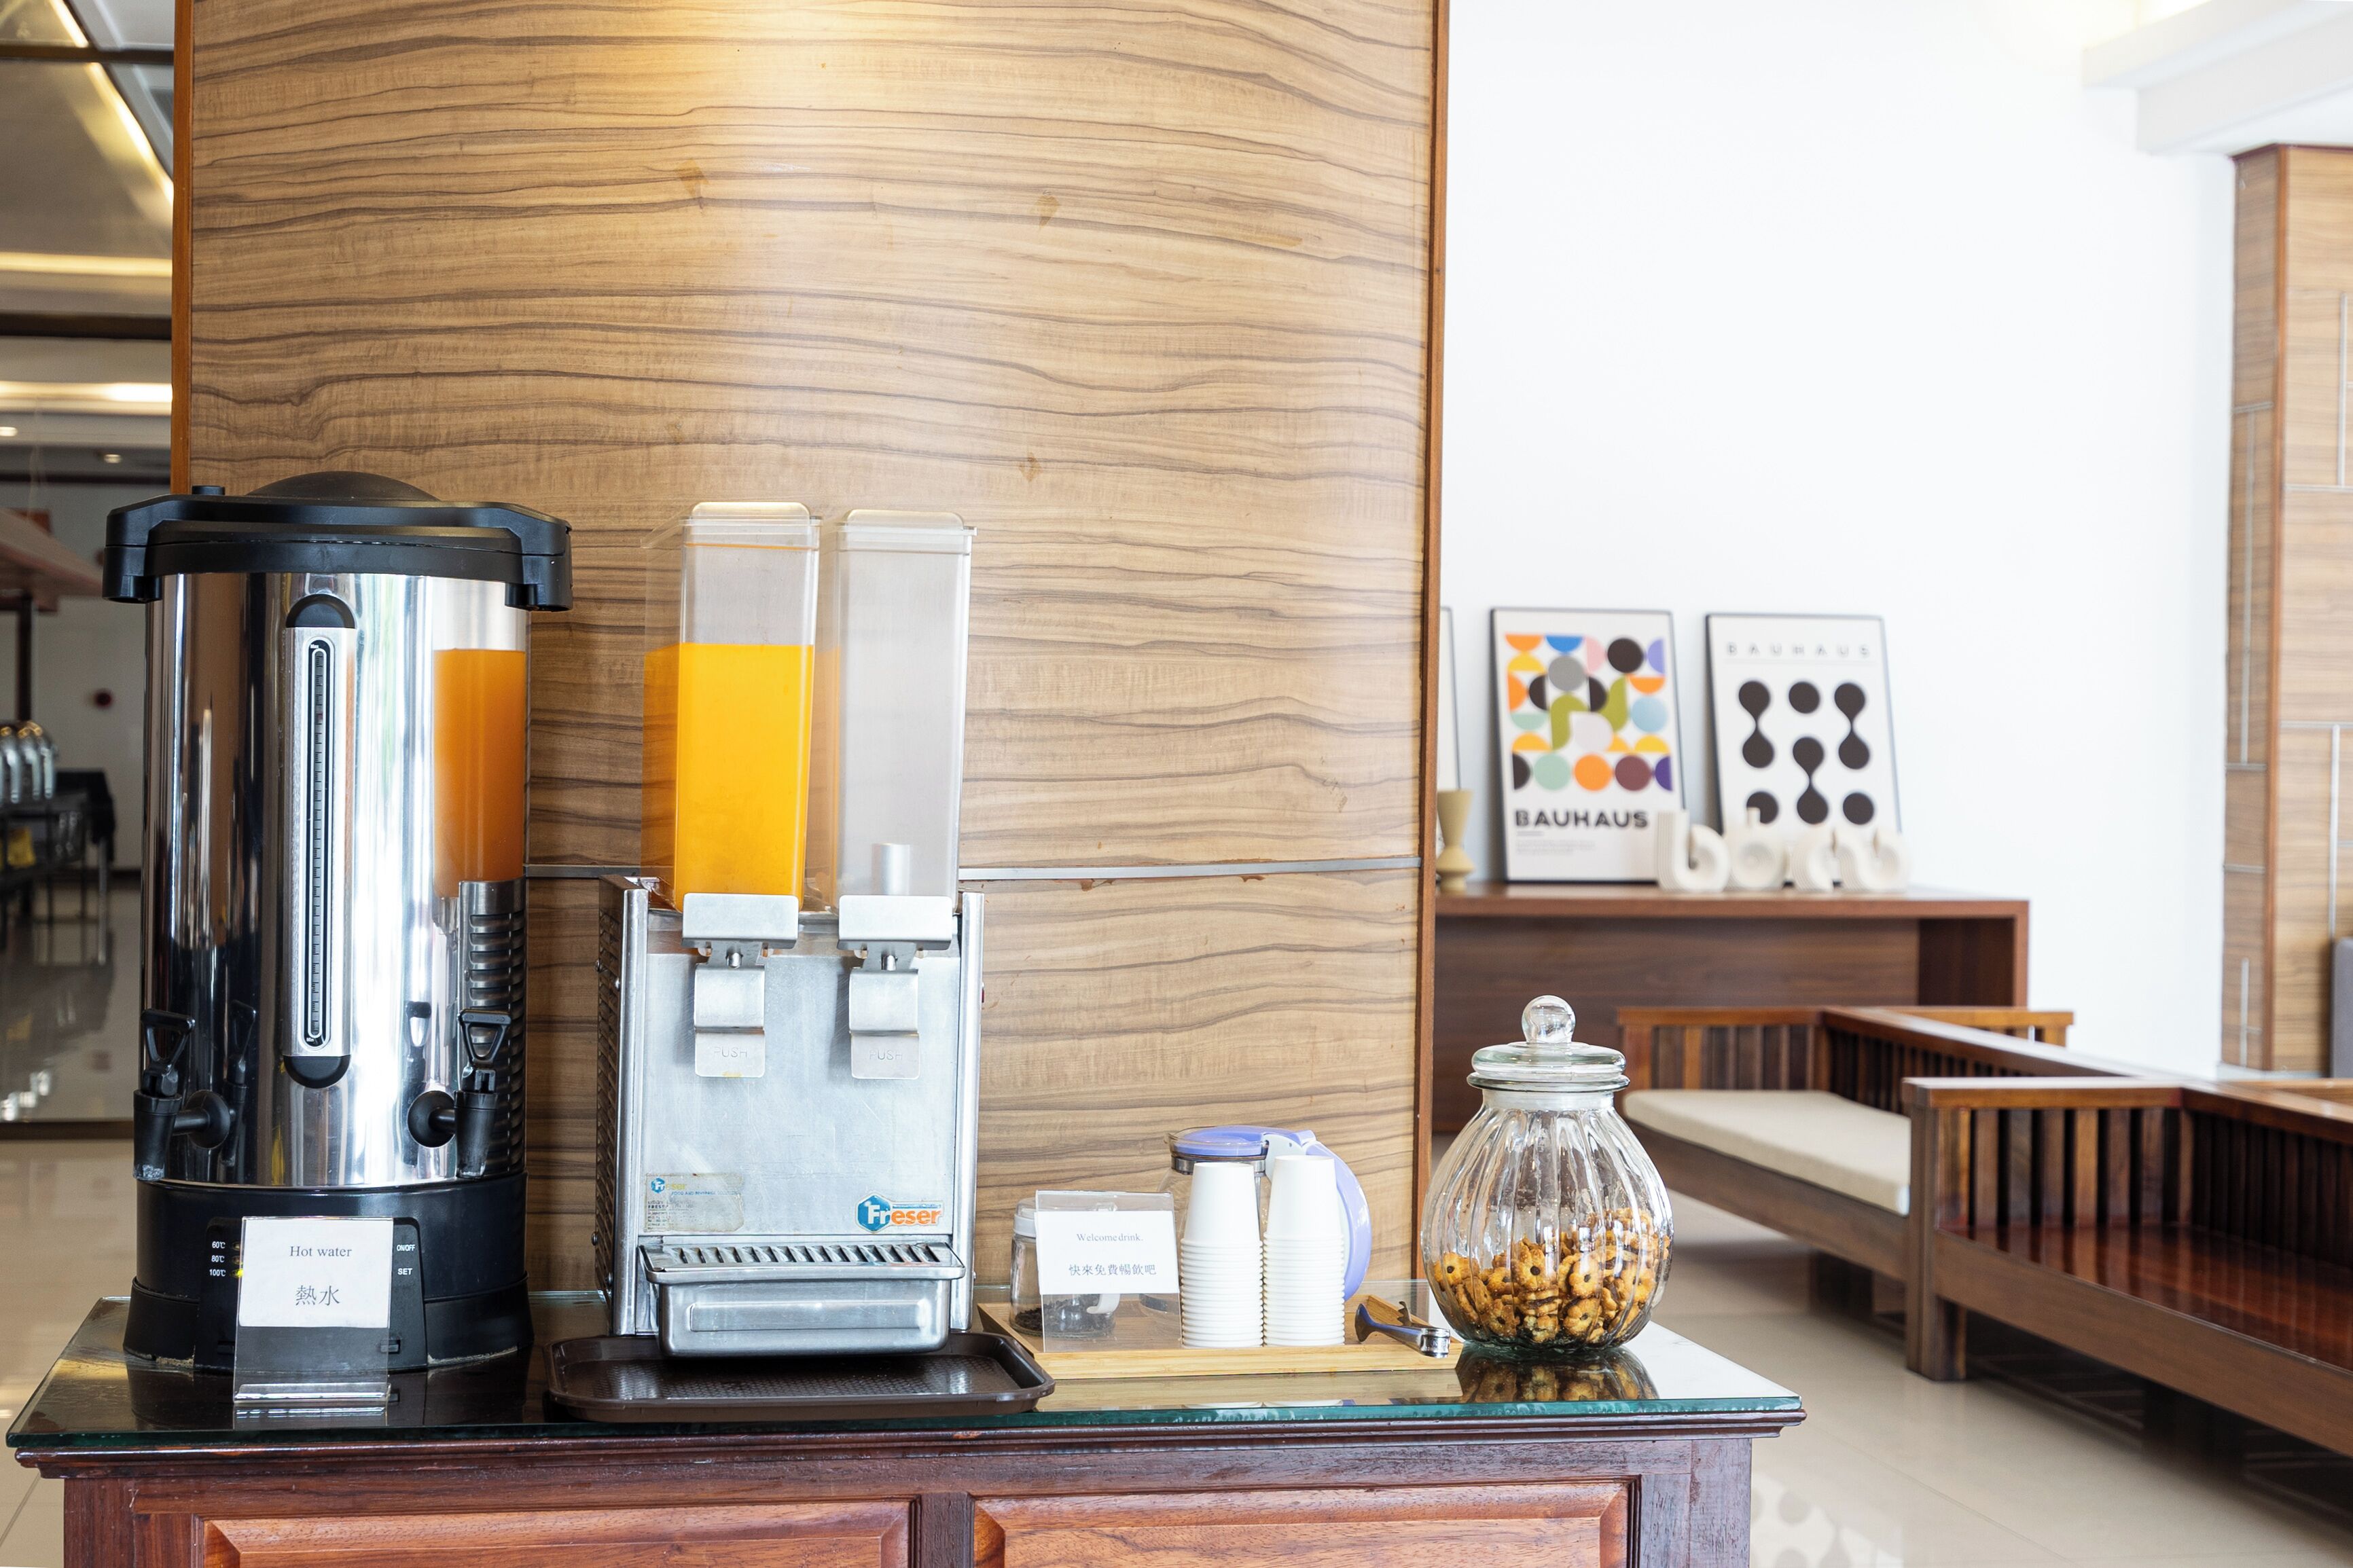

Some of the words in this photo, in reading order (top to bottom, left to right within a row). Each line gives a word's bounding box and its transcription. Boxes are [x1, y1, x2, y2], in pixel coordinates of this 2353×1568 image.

[1726, 642, 1870, 658] BAUHAUS
[1515, 809, 1649, 828] BAUHAUS
[713, 1046, 747, 1058] PUSH
[869, 1049, 903, 1060] PUSH
[867, 1204, 941, 1225] Freser
[1077, 1233, 1117, 1241] Welcome
[1118, 1233, 1144, 1241] drink.
[290, 1245, 312, 1257] Hot
[317, 1247, 352, 1257] water
[1068, 1263, 1157, 1276] 快來免費暢飲吧
[295, 1285, 340, 1306] 熱水
